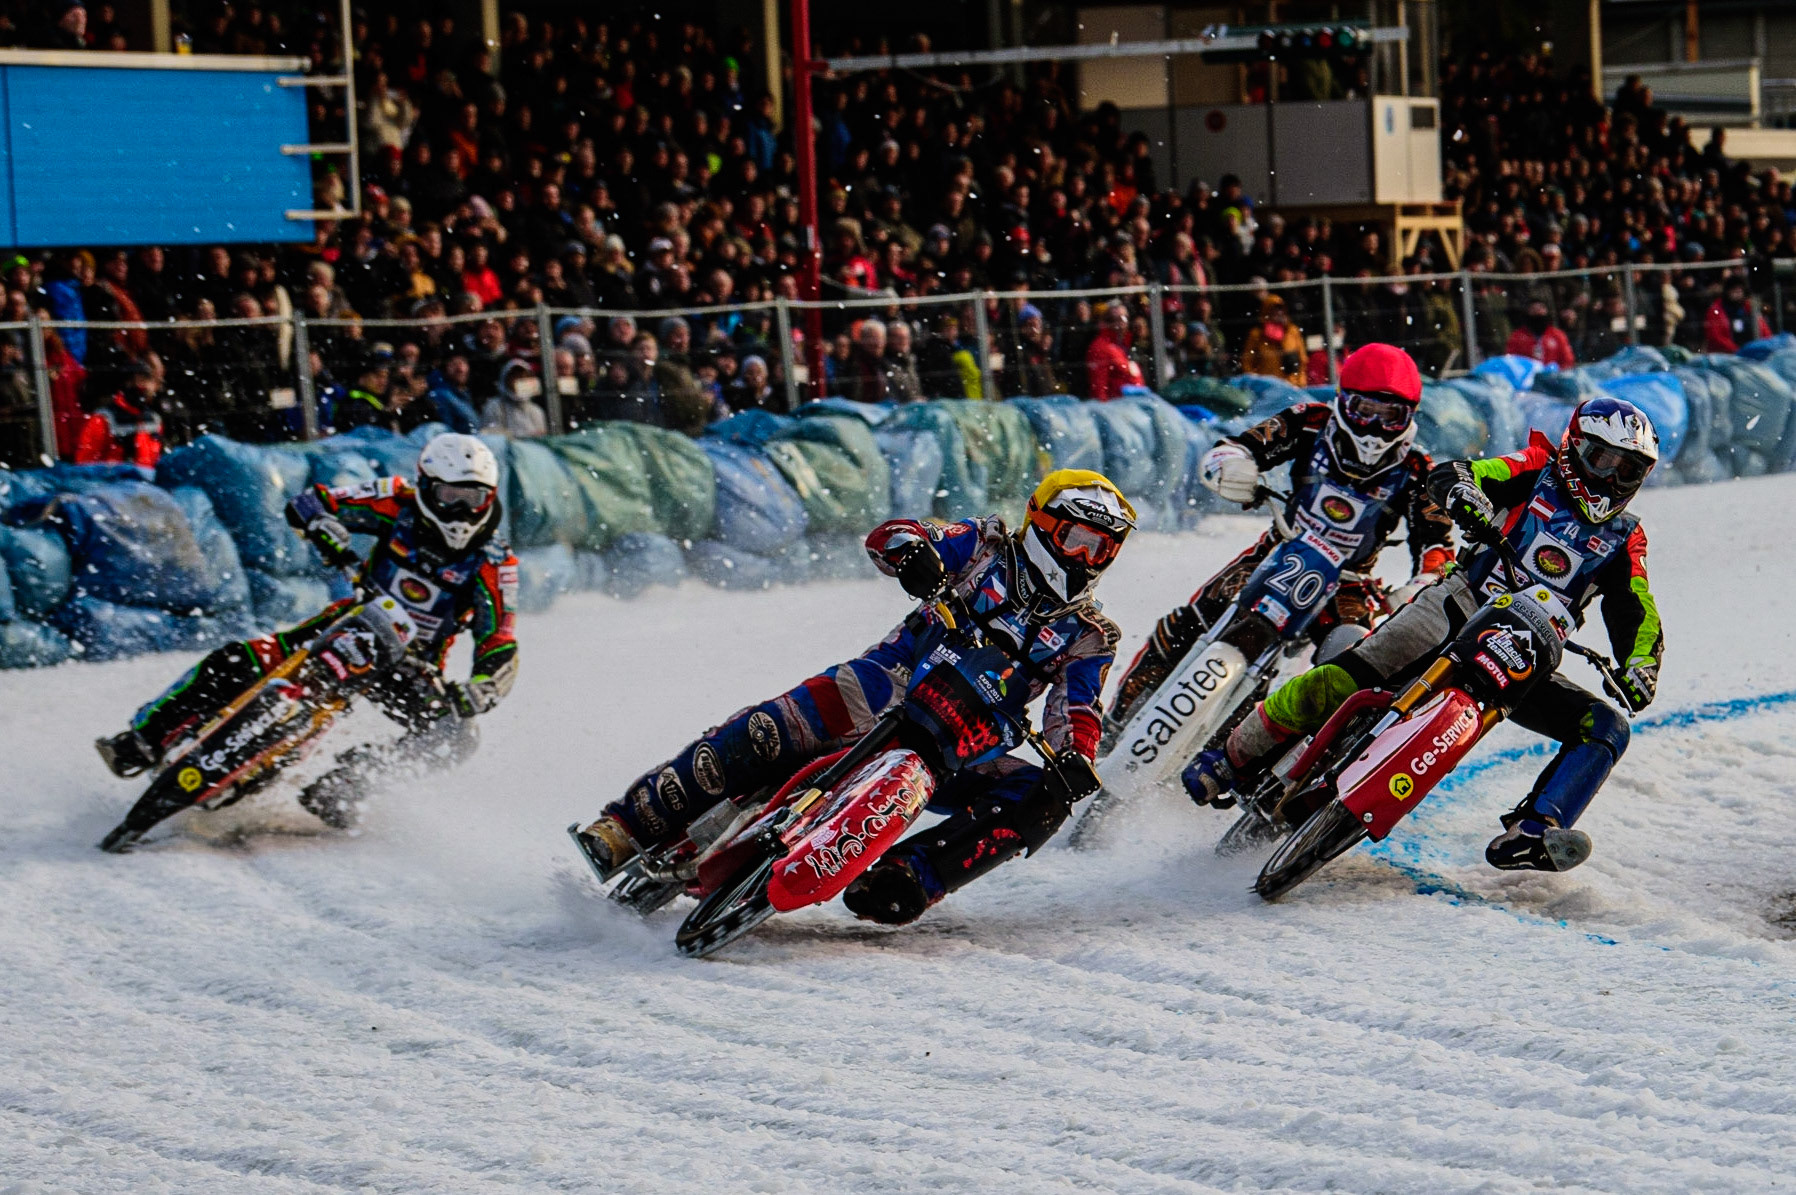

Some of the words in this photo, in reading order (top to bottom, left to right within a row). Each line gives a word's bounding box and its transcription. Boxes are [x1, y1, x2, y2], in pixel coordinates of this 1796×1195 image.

[1563, 521, 1581, 541] 14
[1307, 534, 1340, 563] SAVIKKO
[1264, 553, 1326, 610] 20
[1477, 653, 1508, 688] MOTUL
[979, 674, 992, 690] EXPO
[990, 688, 1003, 702] 2017
[661, 772, 684, 811] Atlas
